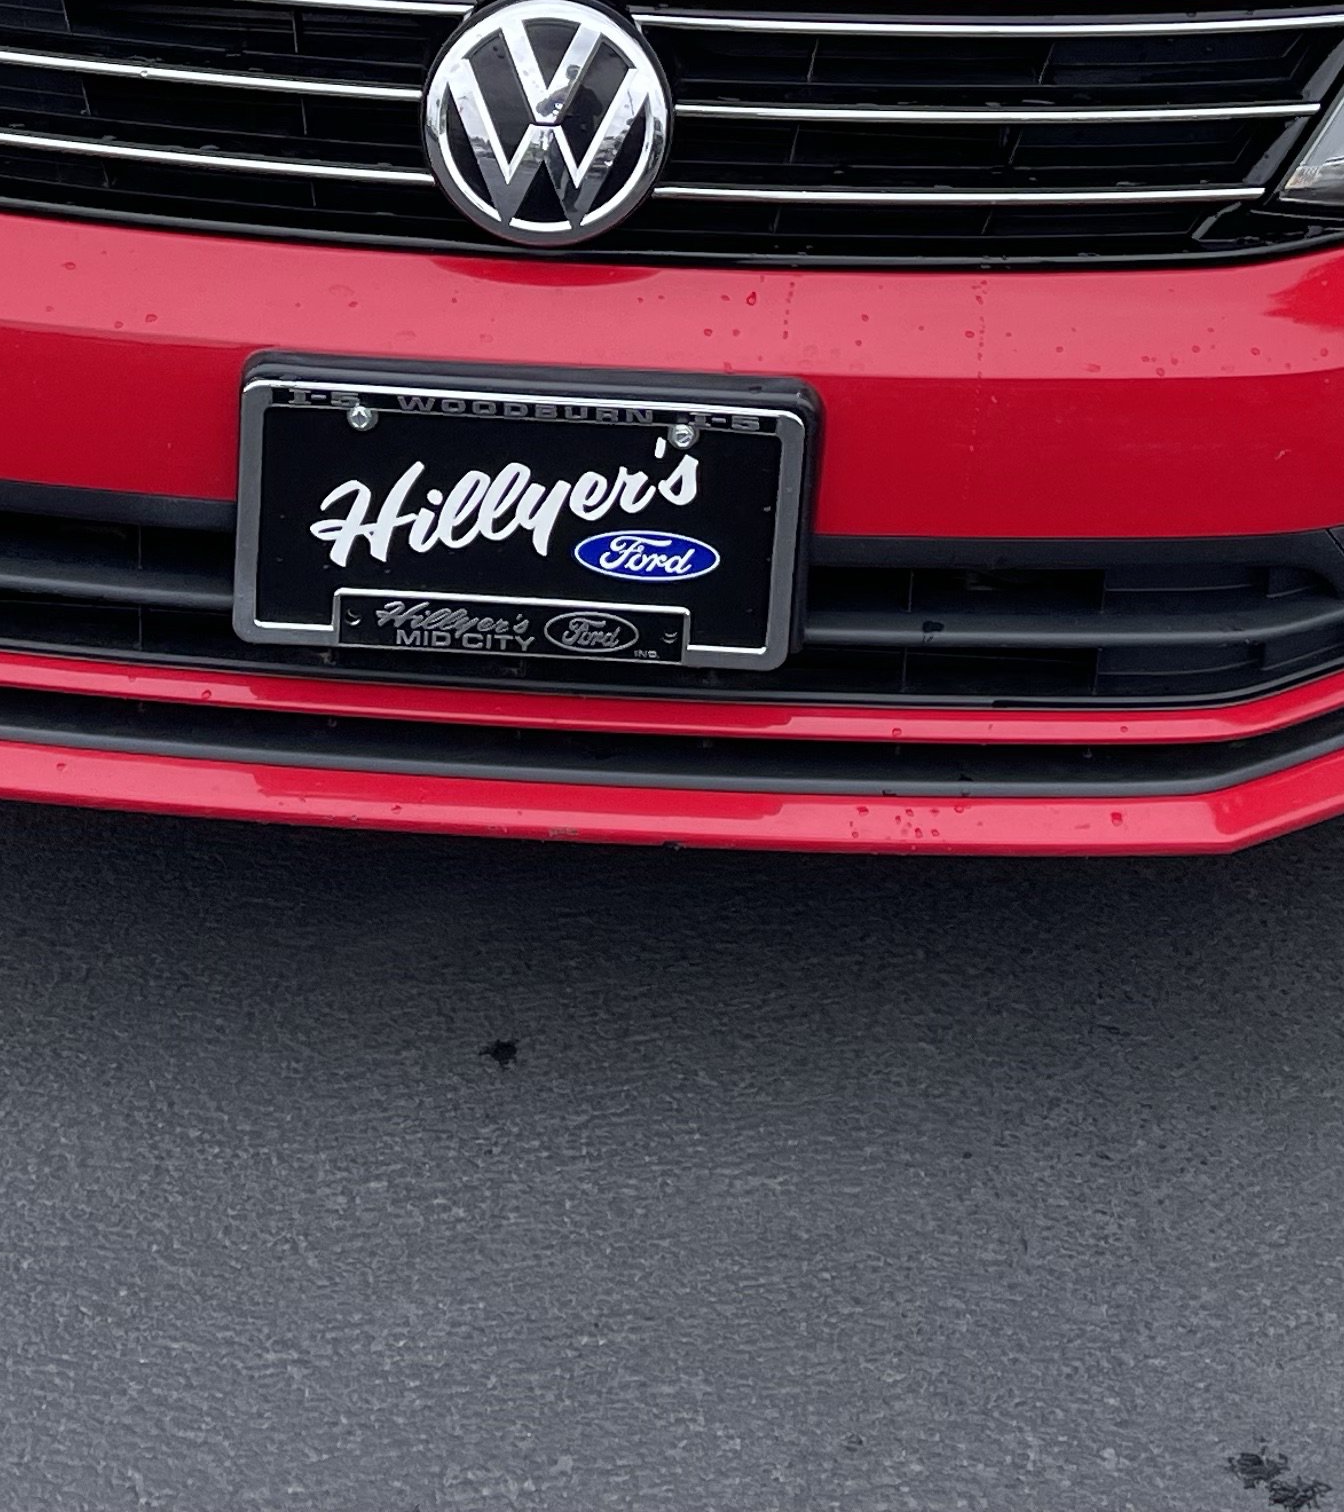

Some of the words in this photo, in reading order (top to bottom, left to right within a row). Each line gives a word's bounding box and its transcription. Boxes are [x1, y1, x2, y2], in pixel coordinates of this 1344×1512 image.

[396, 395, 654, 425] WOODBURN
[309, 436, 700, 568] Hillyer's
[598, 534, 696, 578] Ford
[375, 600, 531, 639] Hillyer's
[560, 616, 620, 649] Ford
[395, 629, 456, 648] MID
[461, 632, 537, 652] CITY
